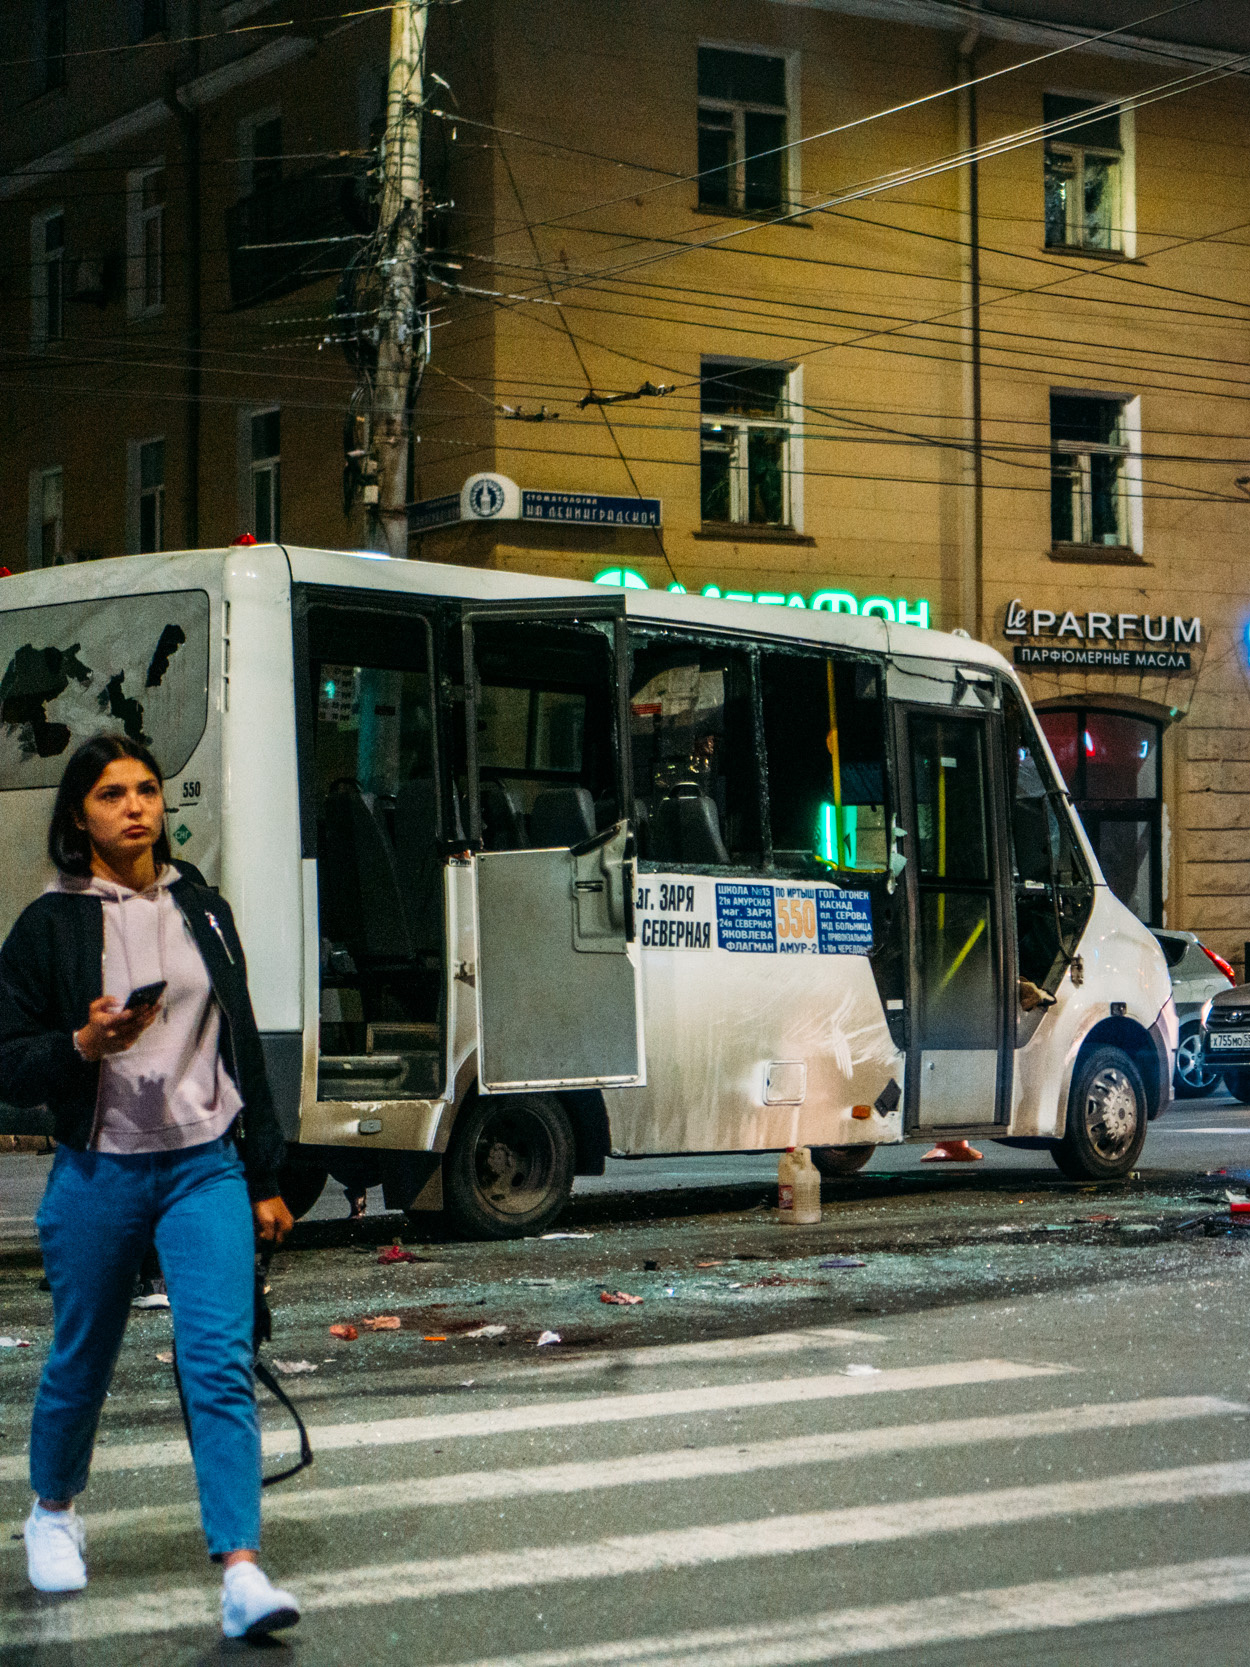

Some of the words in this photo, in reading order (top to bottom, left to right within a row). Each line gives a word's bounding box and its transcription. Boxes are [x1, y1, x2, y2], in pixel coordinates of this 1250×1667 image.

[526, 493, 598, 505] СТОМАТОЛОГИЯ
[526, 504, 542, 517] НА
[549, 505, 656, 525] ЛЕНИНГРАДСКОЙ
[1032, 609, 1201, 643] PARFUM
[1022, 649, 1130, 665] ПАРФЮМЕРНЫЕ
[1135, 653, 1186, 668] МАСЛА
[183, 781, 201, 798] 550
[717, 885, 749, 895] ШКОЛА
[751, 887, 771, 896] №15
[818, 889, 837, 900] ГОЛ.
[839, 890, 870, 900] ОГОНЕК
[635, 887, 655, 911] аг.
[660, 884, 695, 912] ЗАРЯ
[733, 897, 771, 907] АМУРСКАЯ
[819, 900, 853, 911] КАСКАД
[722, 908, 743, 917] маг.
[747, 907, 772, 917] ЗАРЯ
[836, 911, 868, 920] СЕРОВА
[735, 919, 773, 929] СЕВЕРНАЯ
[777, 899, 816, 939] 550
[835, 921, 872, 932] БОЛЬНИЦА
[642, 918, 711, 949] СЕВЕРНАЯ
[721, 930, 774, 940] ЯКОВЛЕВА
[726, 941, 774, 952] ФЛАГМАН
[779, 943, 818, 954] АМУР-2
